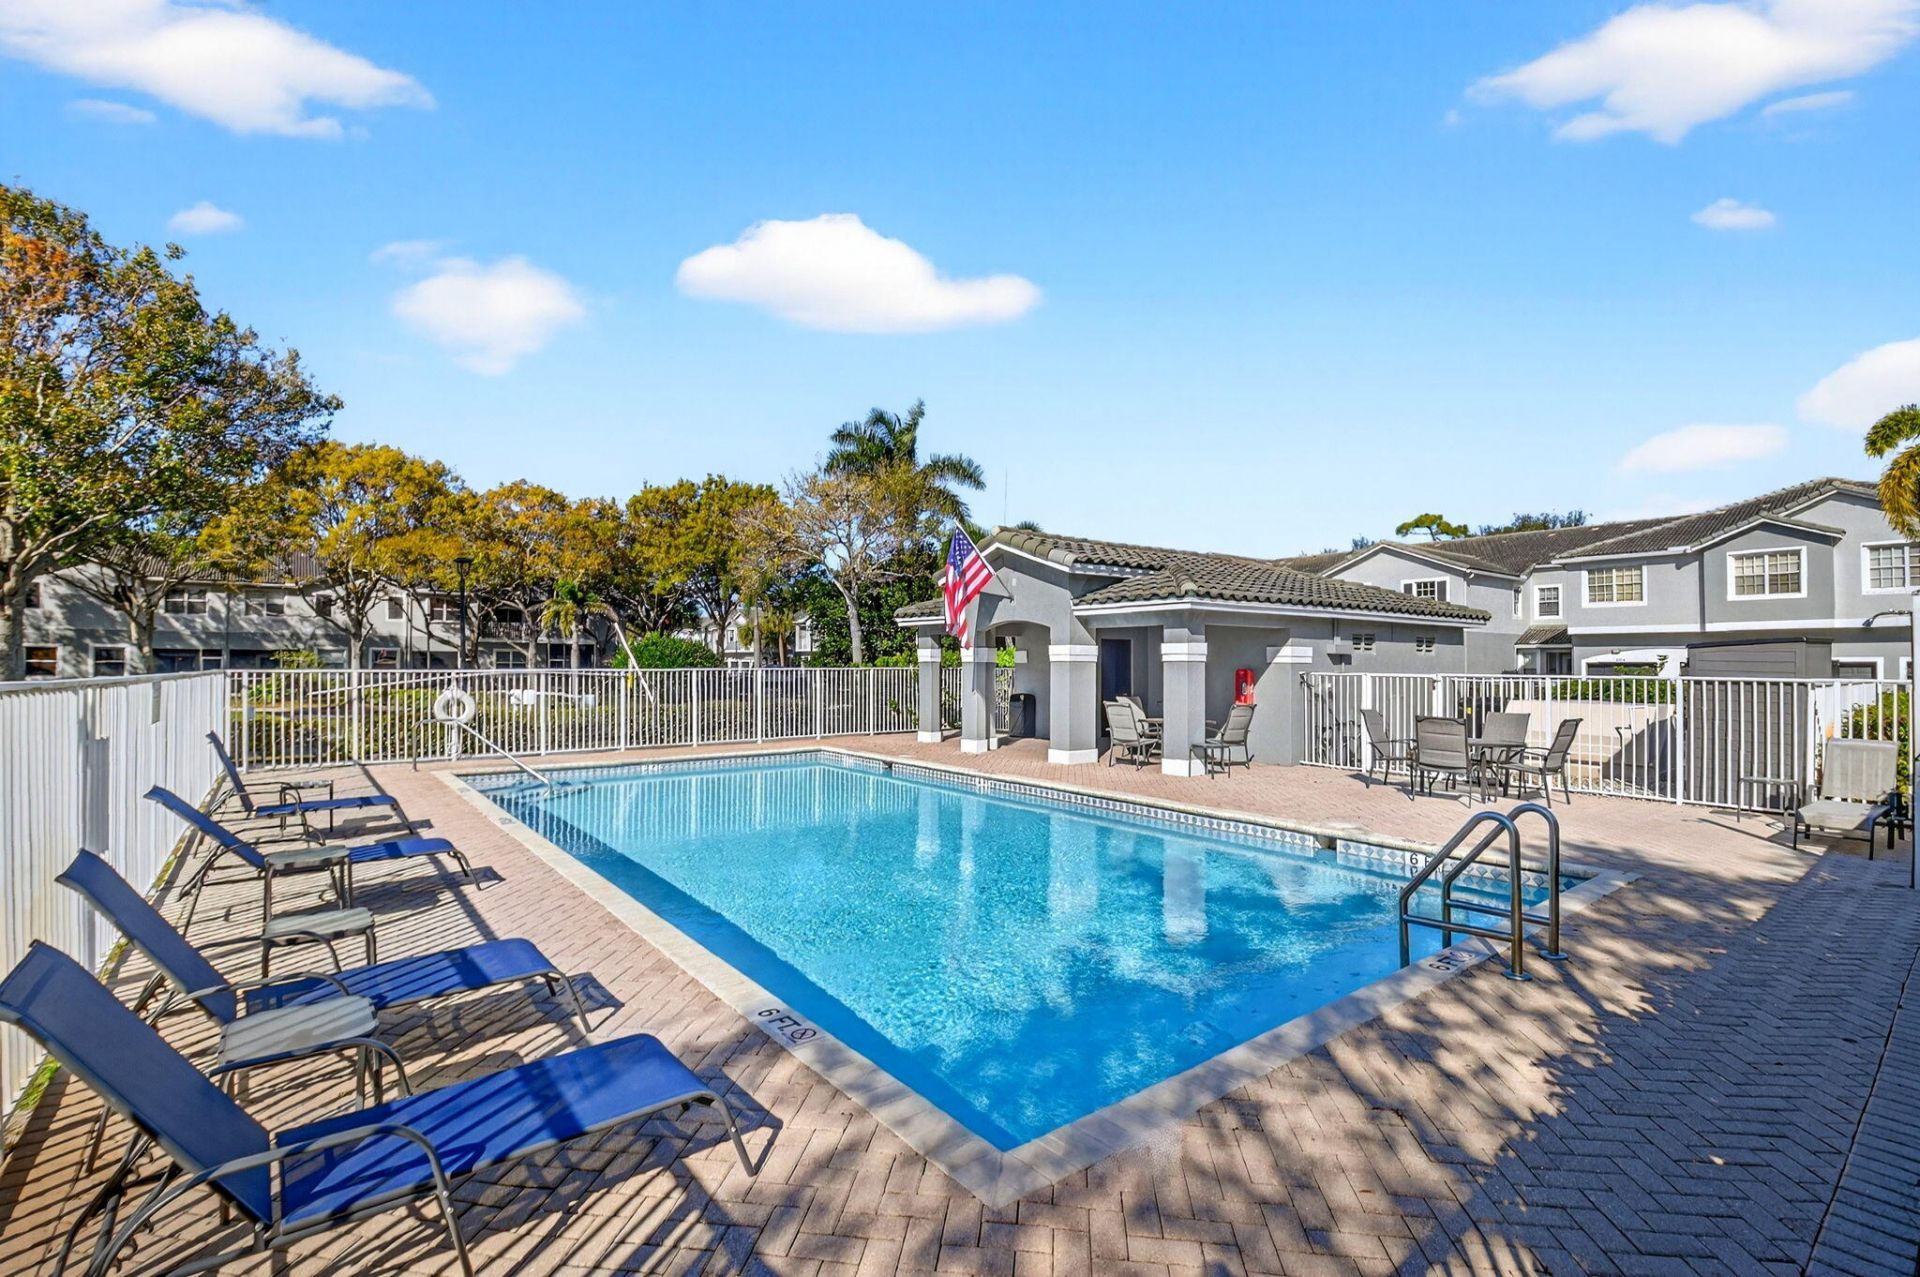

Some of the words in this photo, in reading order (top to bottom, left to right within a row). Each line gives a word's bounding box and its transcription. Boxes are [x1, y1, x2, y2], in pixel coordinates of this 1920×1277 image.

[1410, 852, 1419, 865] 6
[1428, 963, 1450, 971] 6
[757, 1008, 780, 1018] 6
